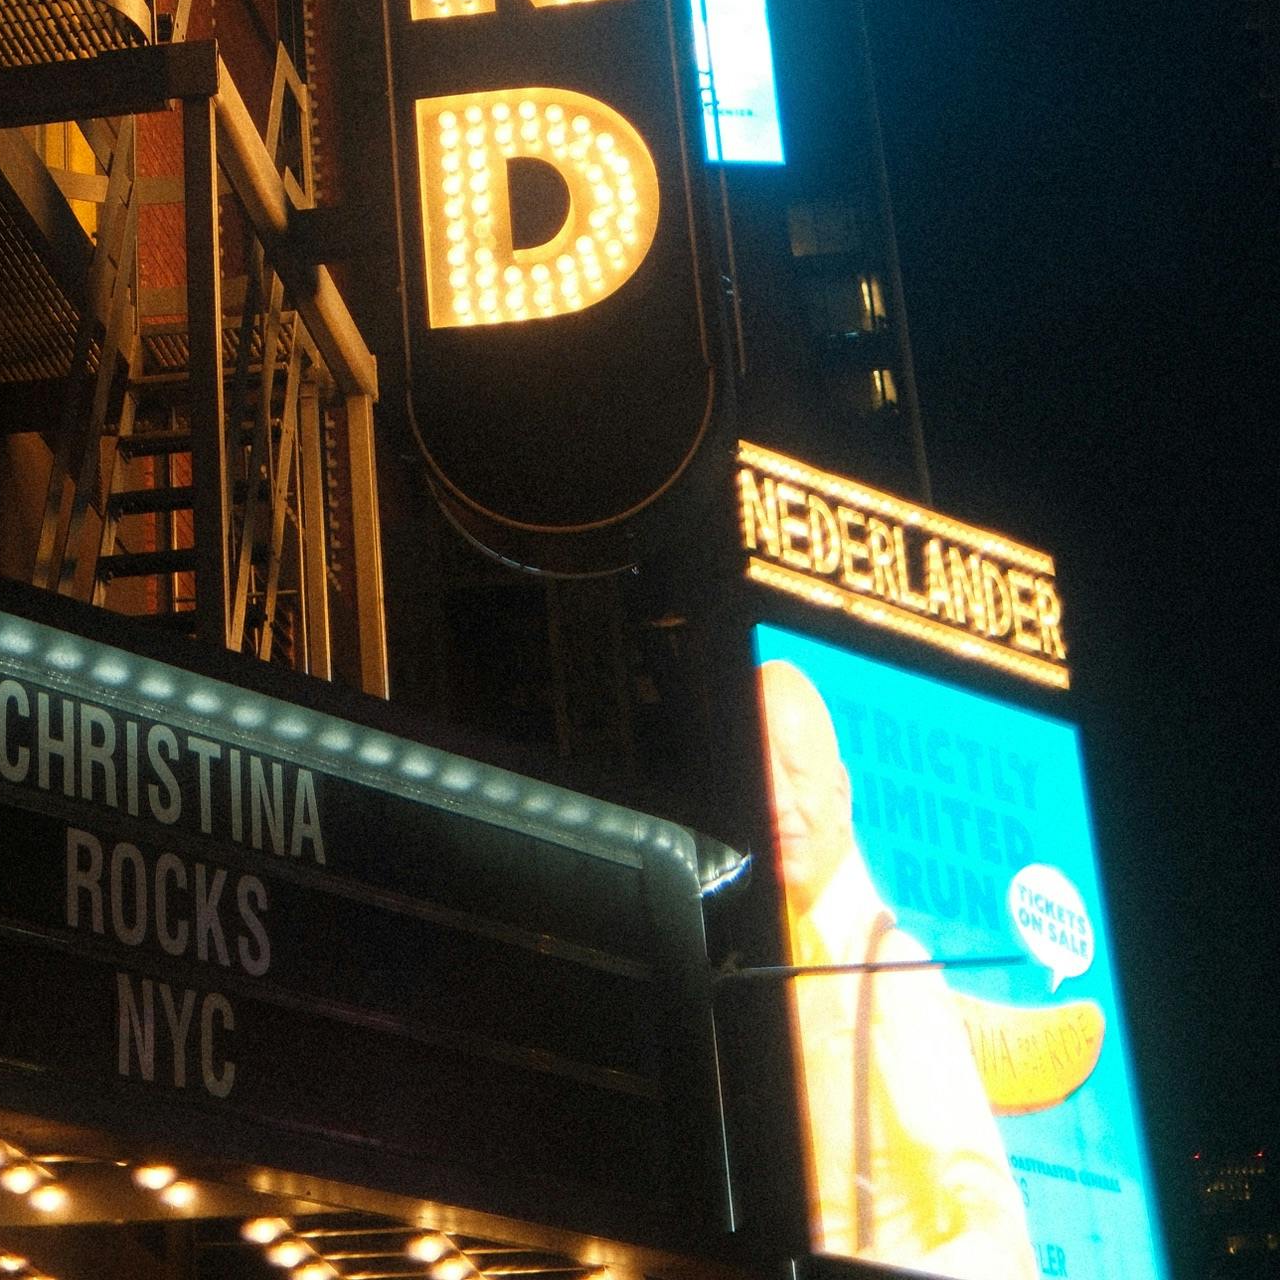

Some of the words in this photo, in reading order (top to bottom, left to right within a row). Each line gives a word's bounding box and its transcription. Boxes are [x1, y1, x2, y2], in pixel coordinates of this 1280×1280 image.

[740, 469, 1066, 660] NEDERLANDER
[835, 696, 1040, 811] TRICTLY
[850, 769, 1035, 870] IMITED
[66, 827, 271, 976] ROCKS
[892, 847, 1001, 931] RUN
[1017, 882, 1087, 936] TICKETS
[1017, 907, 1043, 935] ON
[1047, 922, 1089, 960] SALE
[118, 972, 236, 1098] NYC
